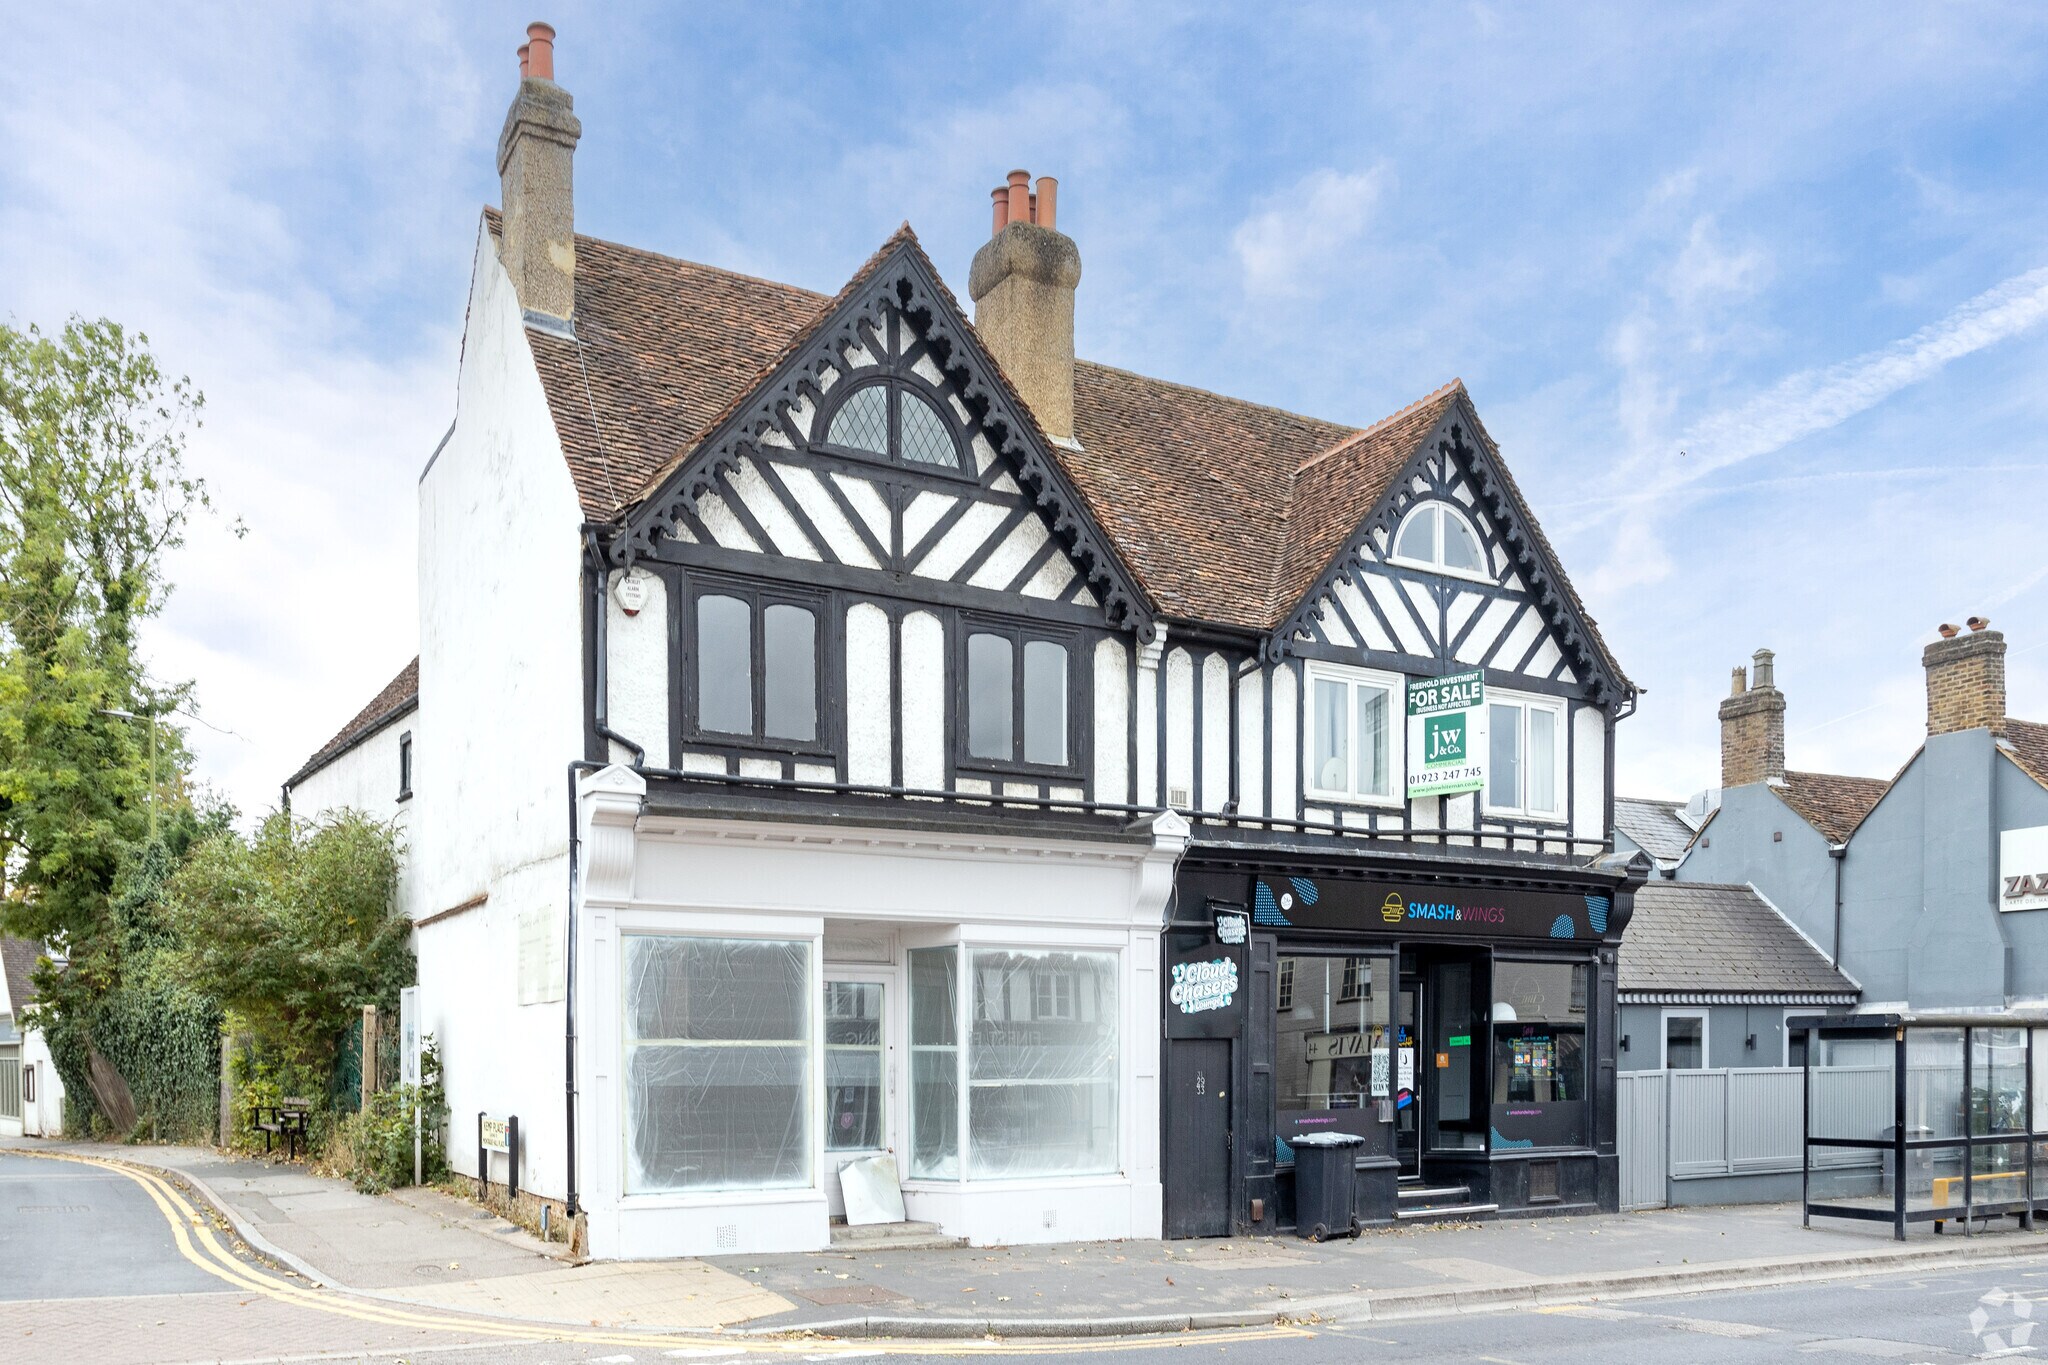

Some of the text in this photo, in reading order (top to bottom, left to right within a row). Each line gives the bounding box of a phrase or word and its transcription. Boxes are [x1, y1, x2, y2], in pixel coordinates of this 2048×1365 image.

[1409, 673, 1479, 691] FREEHOLD INVESTMENT
[1409, 682, 1480, 708] FOR SALE
[1416, 699, 1471, 714] (BUSINESS NOT AFFECTED)
[1426, 760, 1464, 769] COMMERCIAL
[1410, 766, 1481, 785] 01923 247 745
[1186, 957, 1231, 983] Cloud
[1170, 975, 1239, 1005] Chasers
